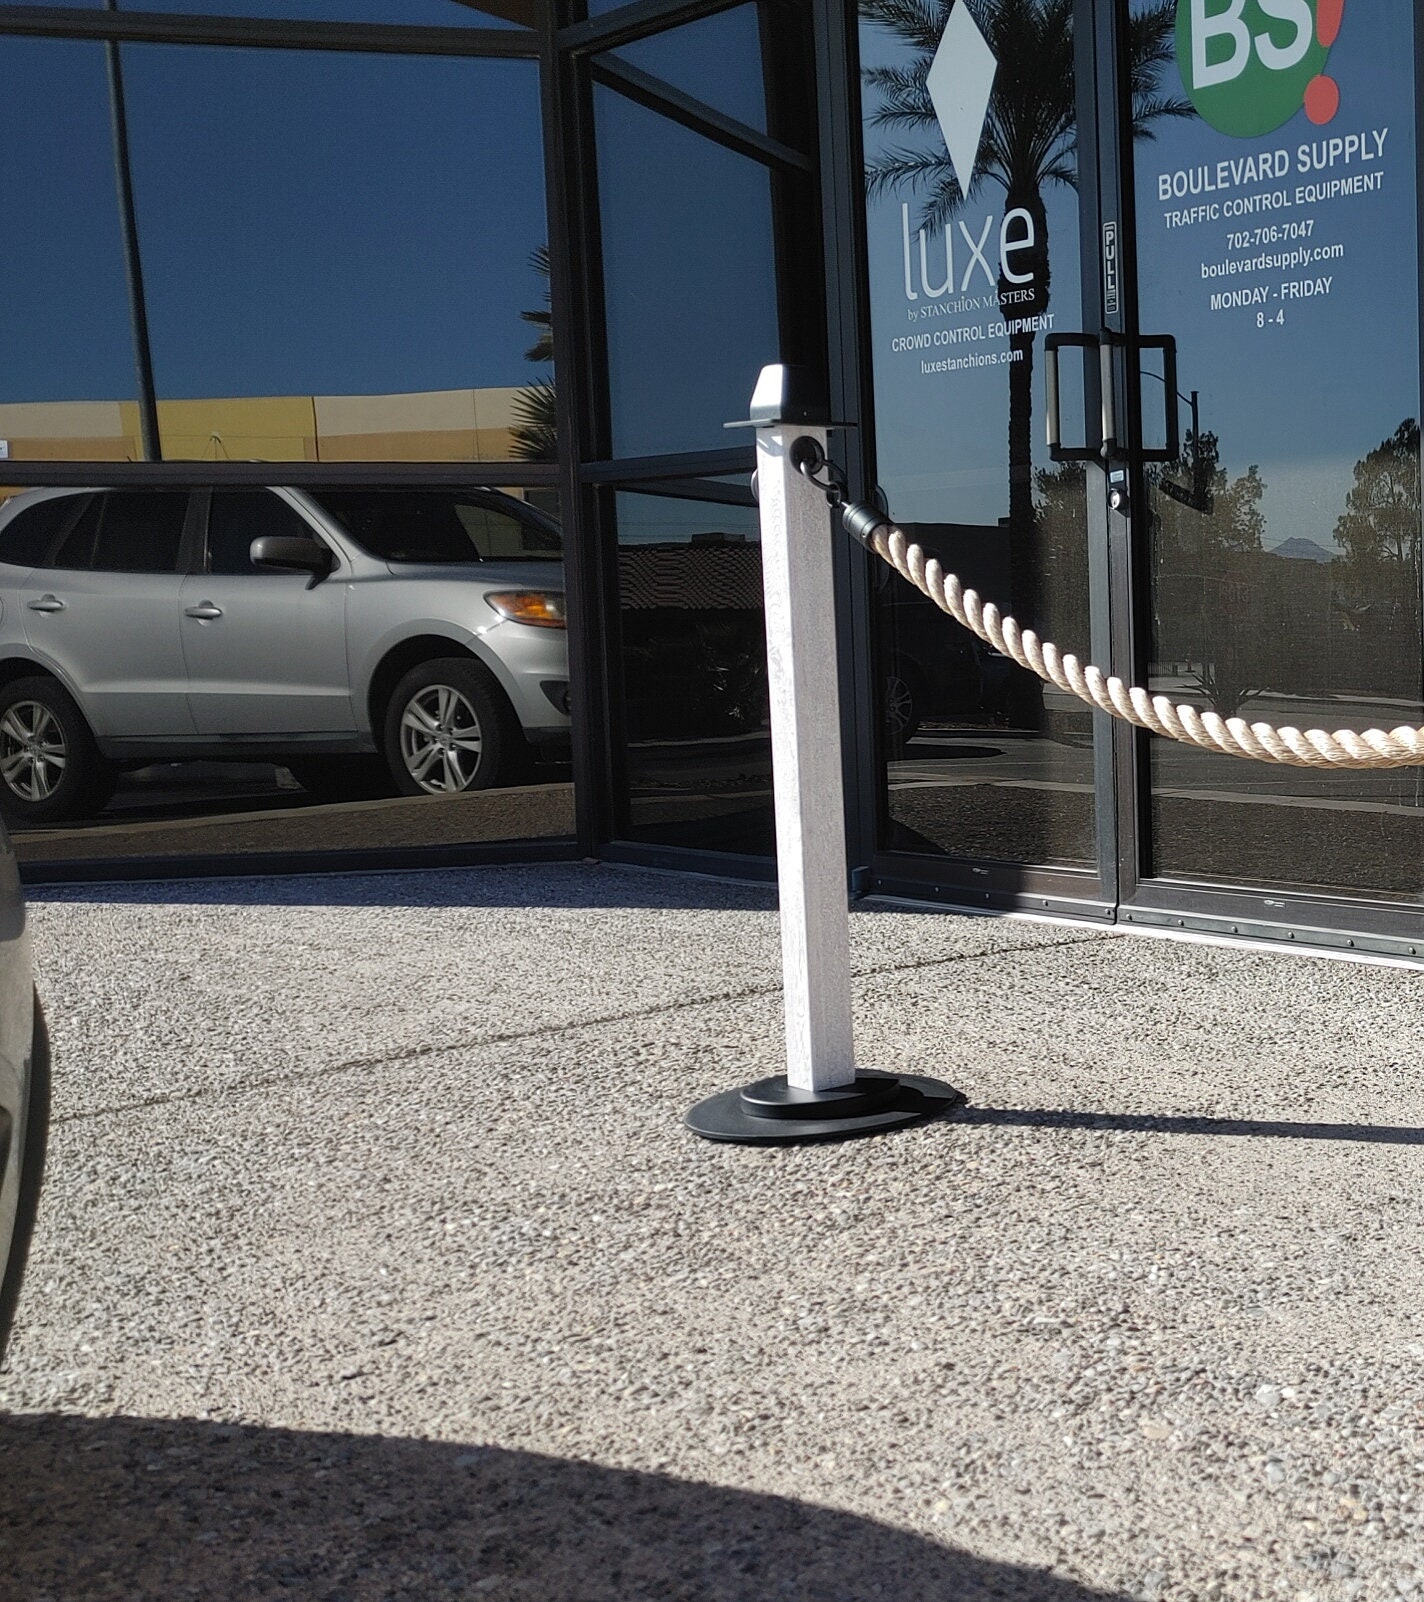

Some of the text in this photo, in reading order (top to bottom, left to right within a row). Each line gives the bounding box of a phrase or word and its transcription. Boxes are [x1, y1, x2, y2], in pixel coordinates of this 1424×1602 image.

[1158, 127, 1389, 201] BOULEVARD SUPPLY
[1164, 171, 1384, 229] TRAFFIC CONTROL EQUIPMENT
[902, 202, 1035, 301] luxe
[1226, 219, 1315, 250] 702-706-7047
[1105, 230, 1115, 290] PULL
[1201, 243, 1344, 279] boulevardsupply.com
[1210, 286, 1270, 311] MONDAY
[1281, 276, 1333, 300] FRIDAY
[891, 313, 1055, 352] CROWD CONTROL EQUIPMENT
[907, 308, 918, 322] by
[1256, 312, 1265, 328] 8
[1276, 309, 1285, 326] 4
[921, 349, 1024, 375] luxestanchions.com
